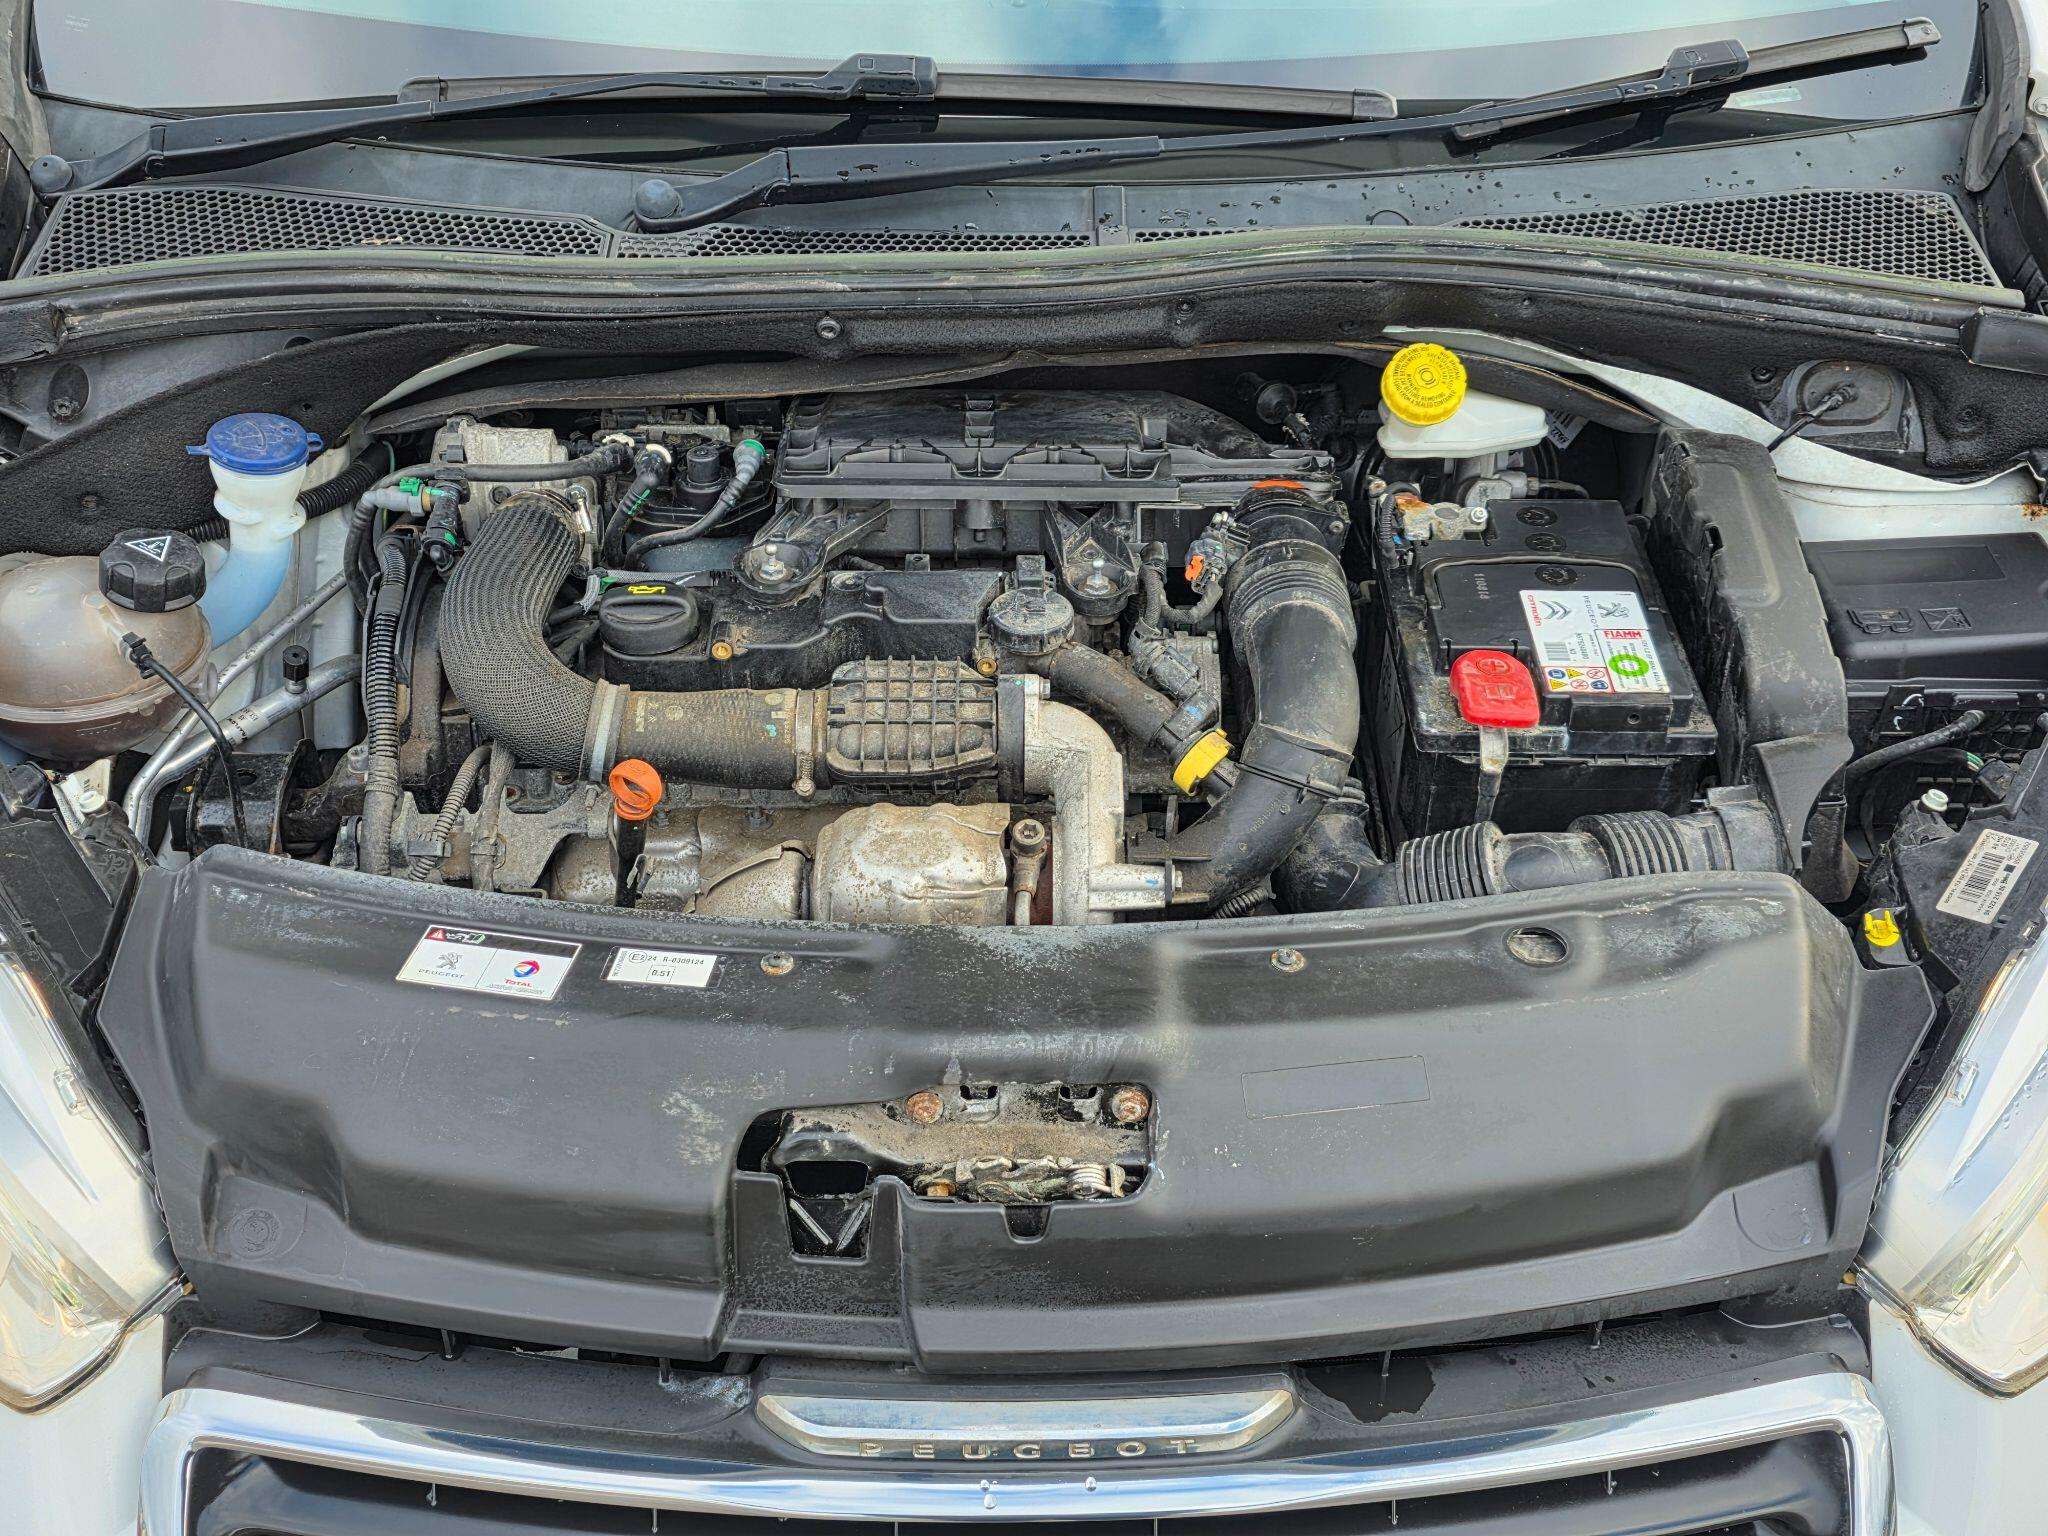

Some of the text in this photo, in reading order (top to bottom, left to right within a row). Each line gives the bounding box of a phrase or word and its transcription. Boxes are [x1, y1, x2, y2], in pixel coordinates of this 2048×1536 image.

[1603, 630, 1642, 638] FIAMM
[504, 978, 533, 988] TOTAL
[858, 1438, 1195, 1460] PEUGEOT
